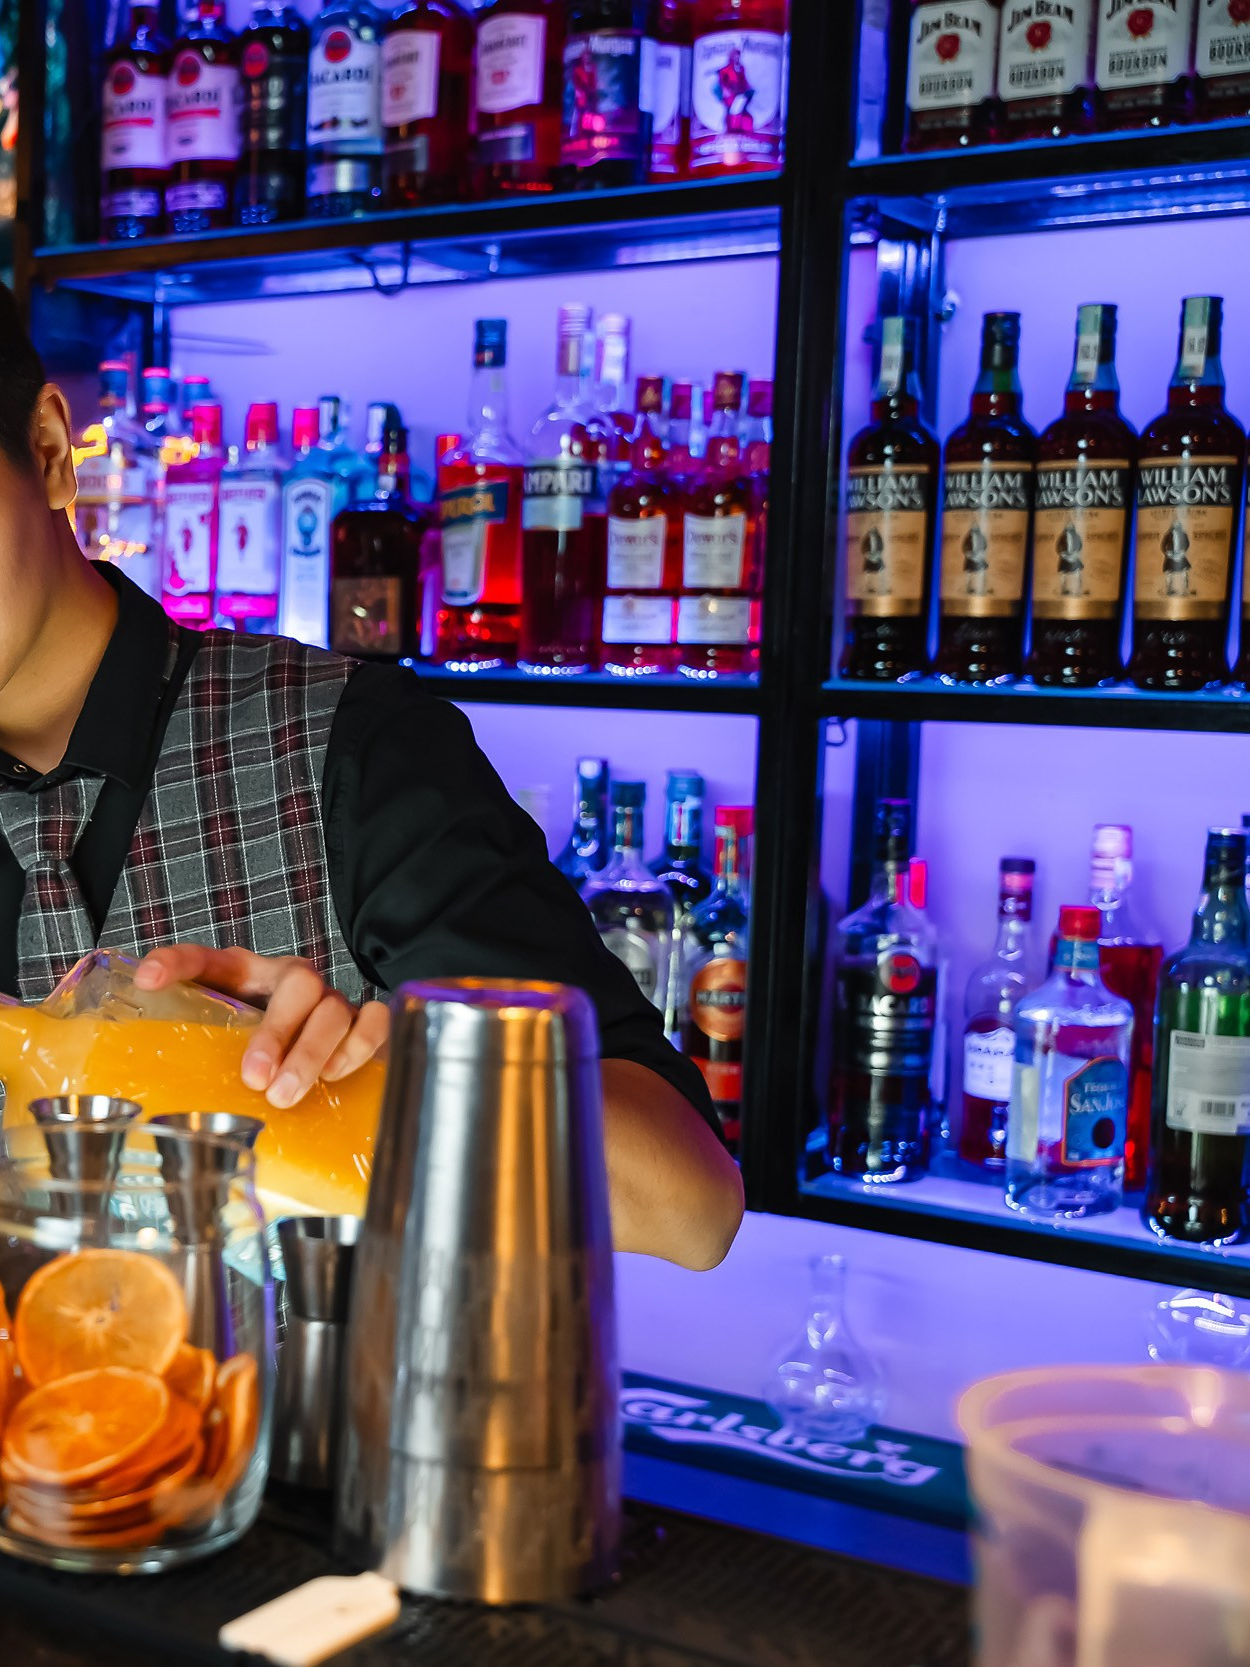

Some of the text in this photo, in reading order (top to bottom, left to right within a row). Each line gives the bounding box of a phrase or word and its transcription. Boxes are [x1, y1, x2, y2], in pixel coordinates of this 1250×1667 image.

[916, 11, 982, 43] JIM BEAM
[1007, 0, 1074, 33] JIM BEAM
[1209, 40, 1250, 61] BOURB
[1109, 52, 1168, 74] BOURBON
[919, 76, 974, 96] BOURBON
[1009, 65, 1065, 86] BOURBON
[524, 469, 593, 495] MPARI
[945, 472, 1023, 492] WILLIAM
[1037, 469, 1119, 489] WILLIAM
[1141, 466, 1227, 486] WILLIAM
[849, 490, 925, 510] AWSON'S
[946, 490, 1027, 509] AWSON'S
[1036, 486, 1123, 507] AWSON'S
[1137, 483, 1231, 505] LAWSON'S
[696, 990, 747, 1007] MART
[859, 995, 932, 1016] ACARD
